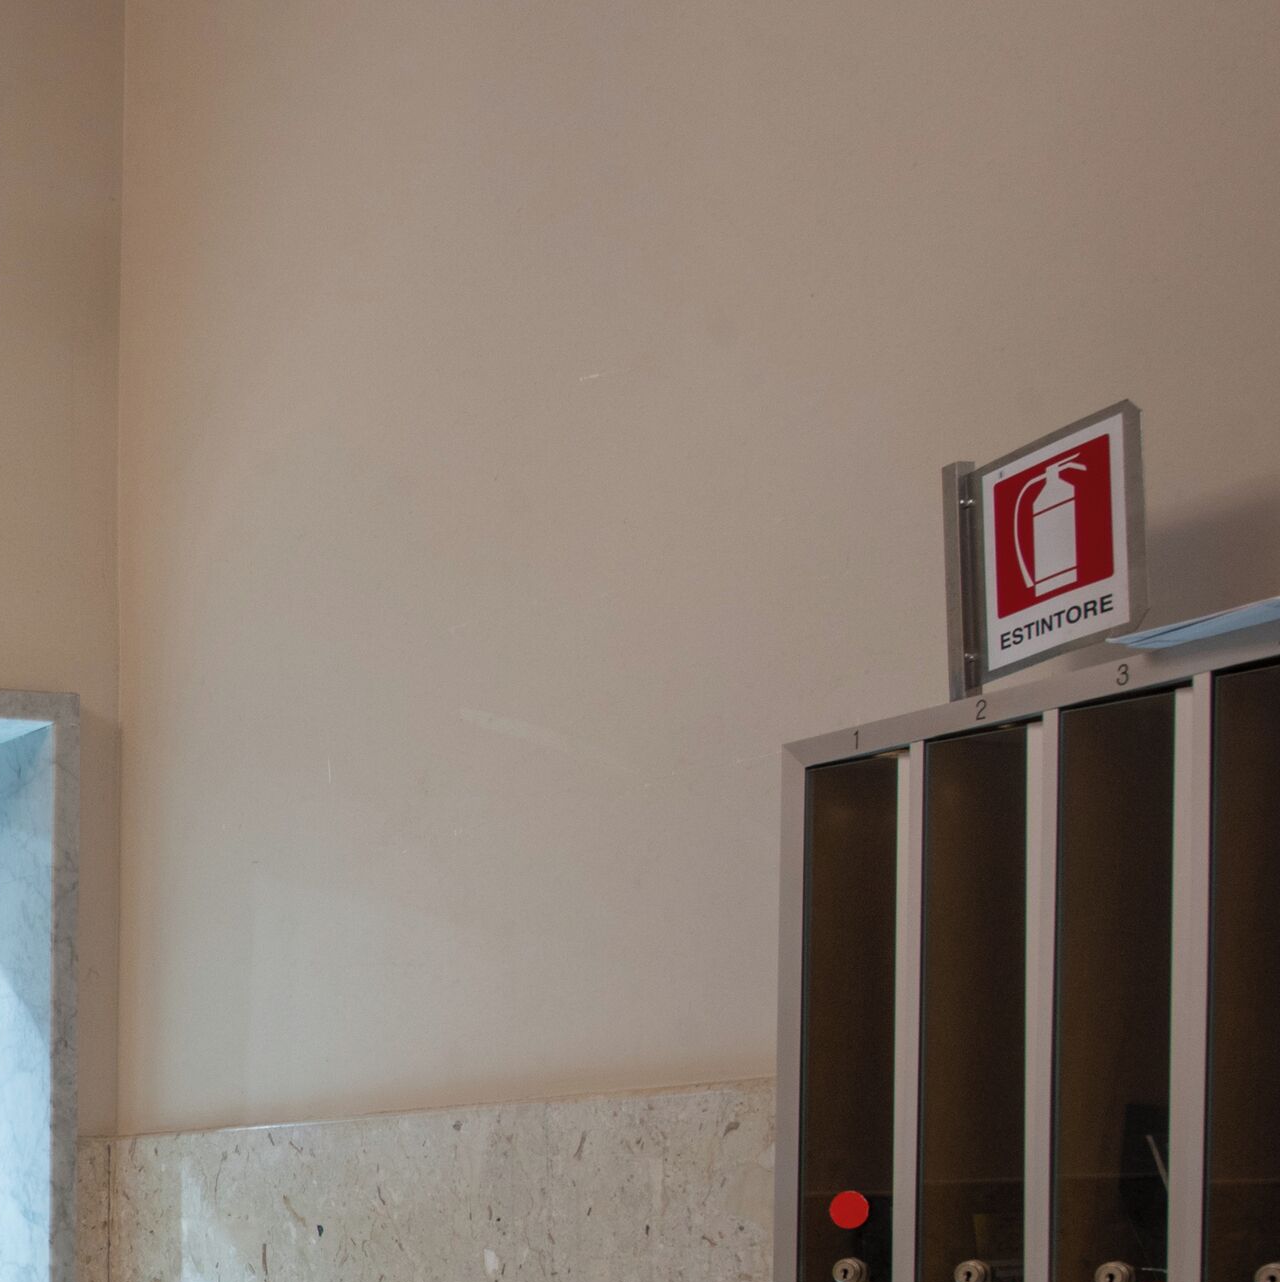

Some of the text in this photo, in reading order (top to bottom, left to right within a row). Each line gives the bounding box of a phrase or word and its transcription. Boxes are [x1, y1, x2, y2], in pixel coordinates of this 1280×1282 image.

[1000, 593, 1114, 651] ESTINTORE
[1116, 664, 1129, 686] 3
[974, 700, 987, 720] 2
[852, 730, 860, 750] 1
